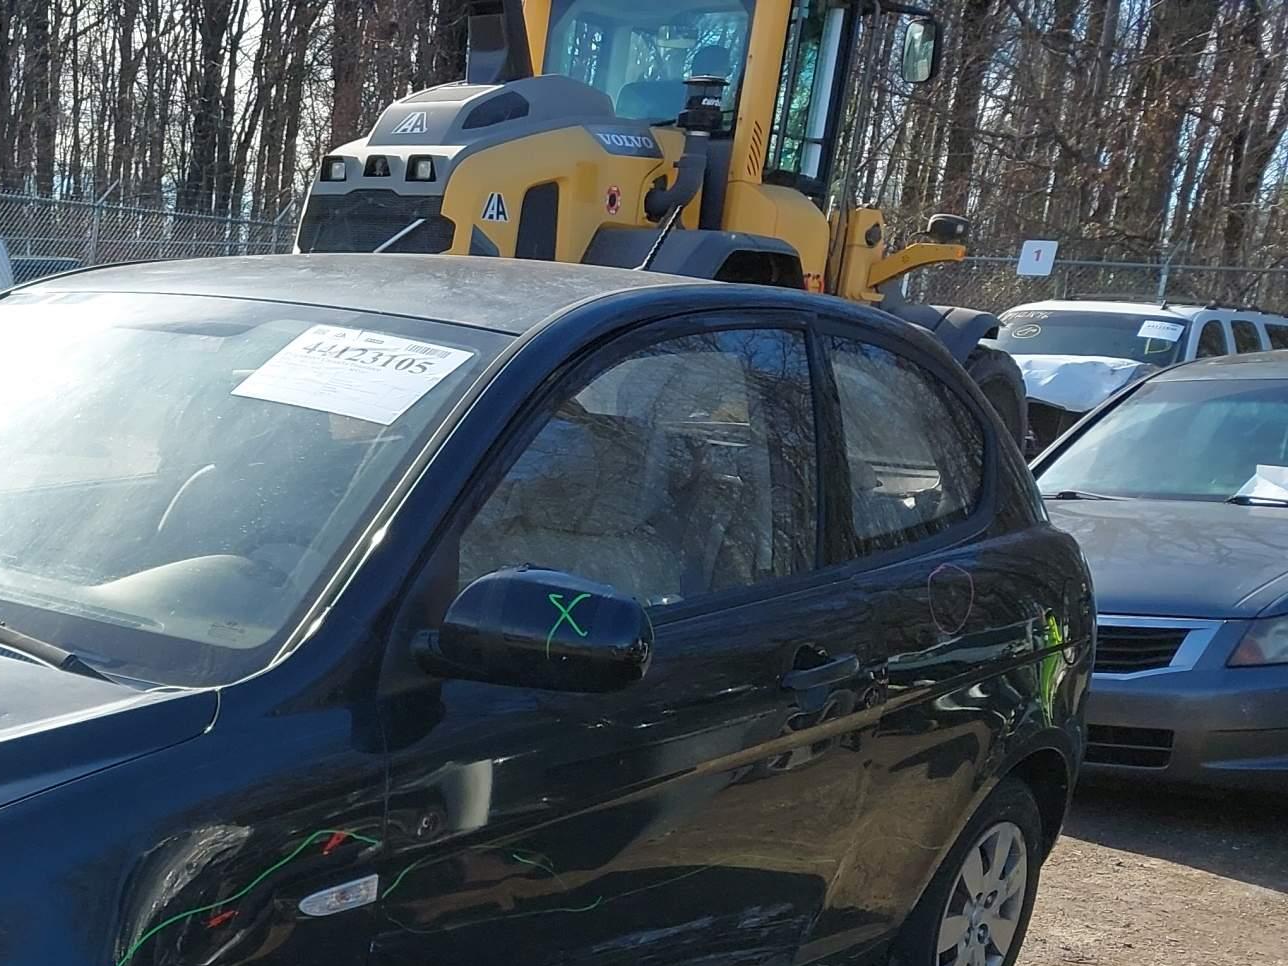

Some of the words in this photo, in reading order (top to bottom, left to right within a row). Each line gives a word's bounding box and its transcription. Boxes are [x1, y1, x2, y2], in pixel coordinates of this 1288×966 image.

[596, 133, 654, 149] VOLVO
[1034, 248, 1042, 262] 1
[303, 341, 435, 375] 44123105
